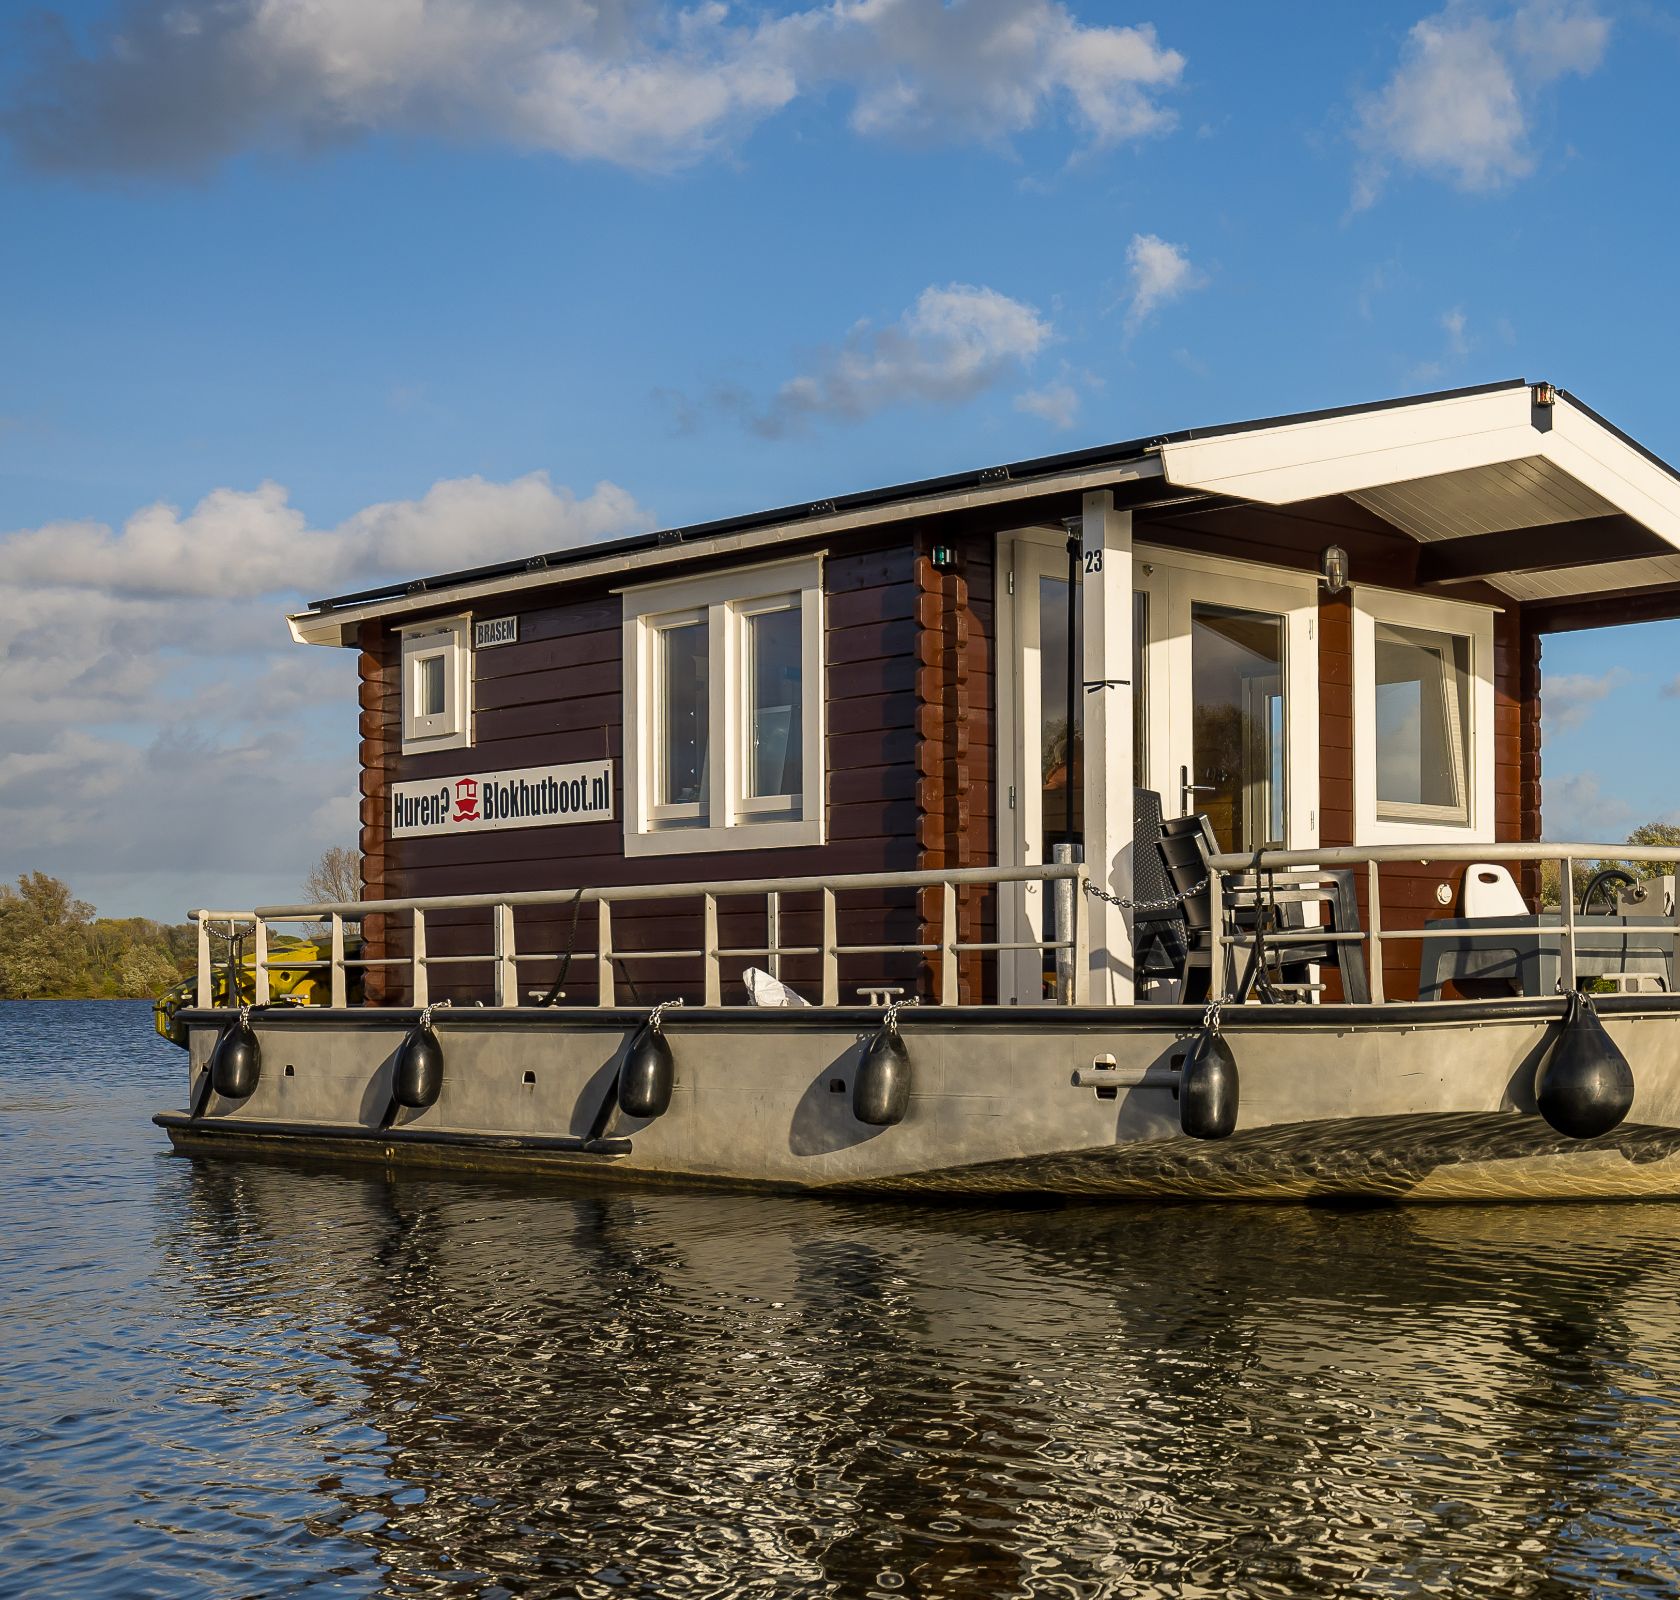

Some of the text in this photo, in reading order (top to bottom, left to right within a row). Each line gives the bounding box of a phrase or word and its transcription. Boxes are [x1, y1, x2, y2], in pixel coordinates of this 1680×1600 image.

[1085, 549, 1102, 573] 23
[477, 620, 516, 645] BRASEM
[394, 769, 610, 828] Huren? Blokhutboot.nl
